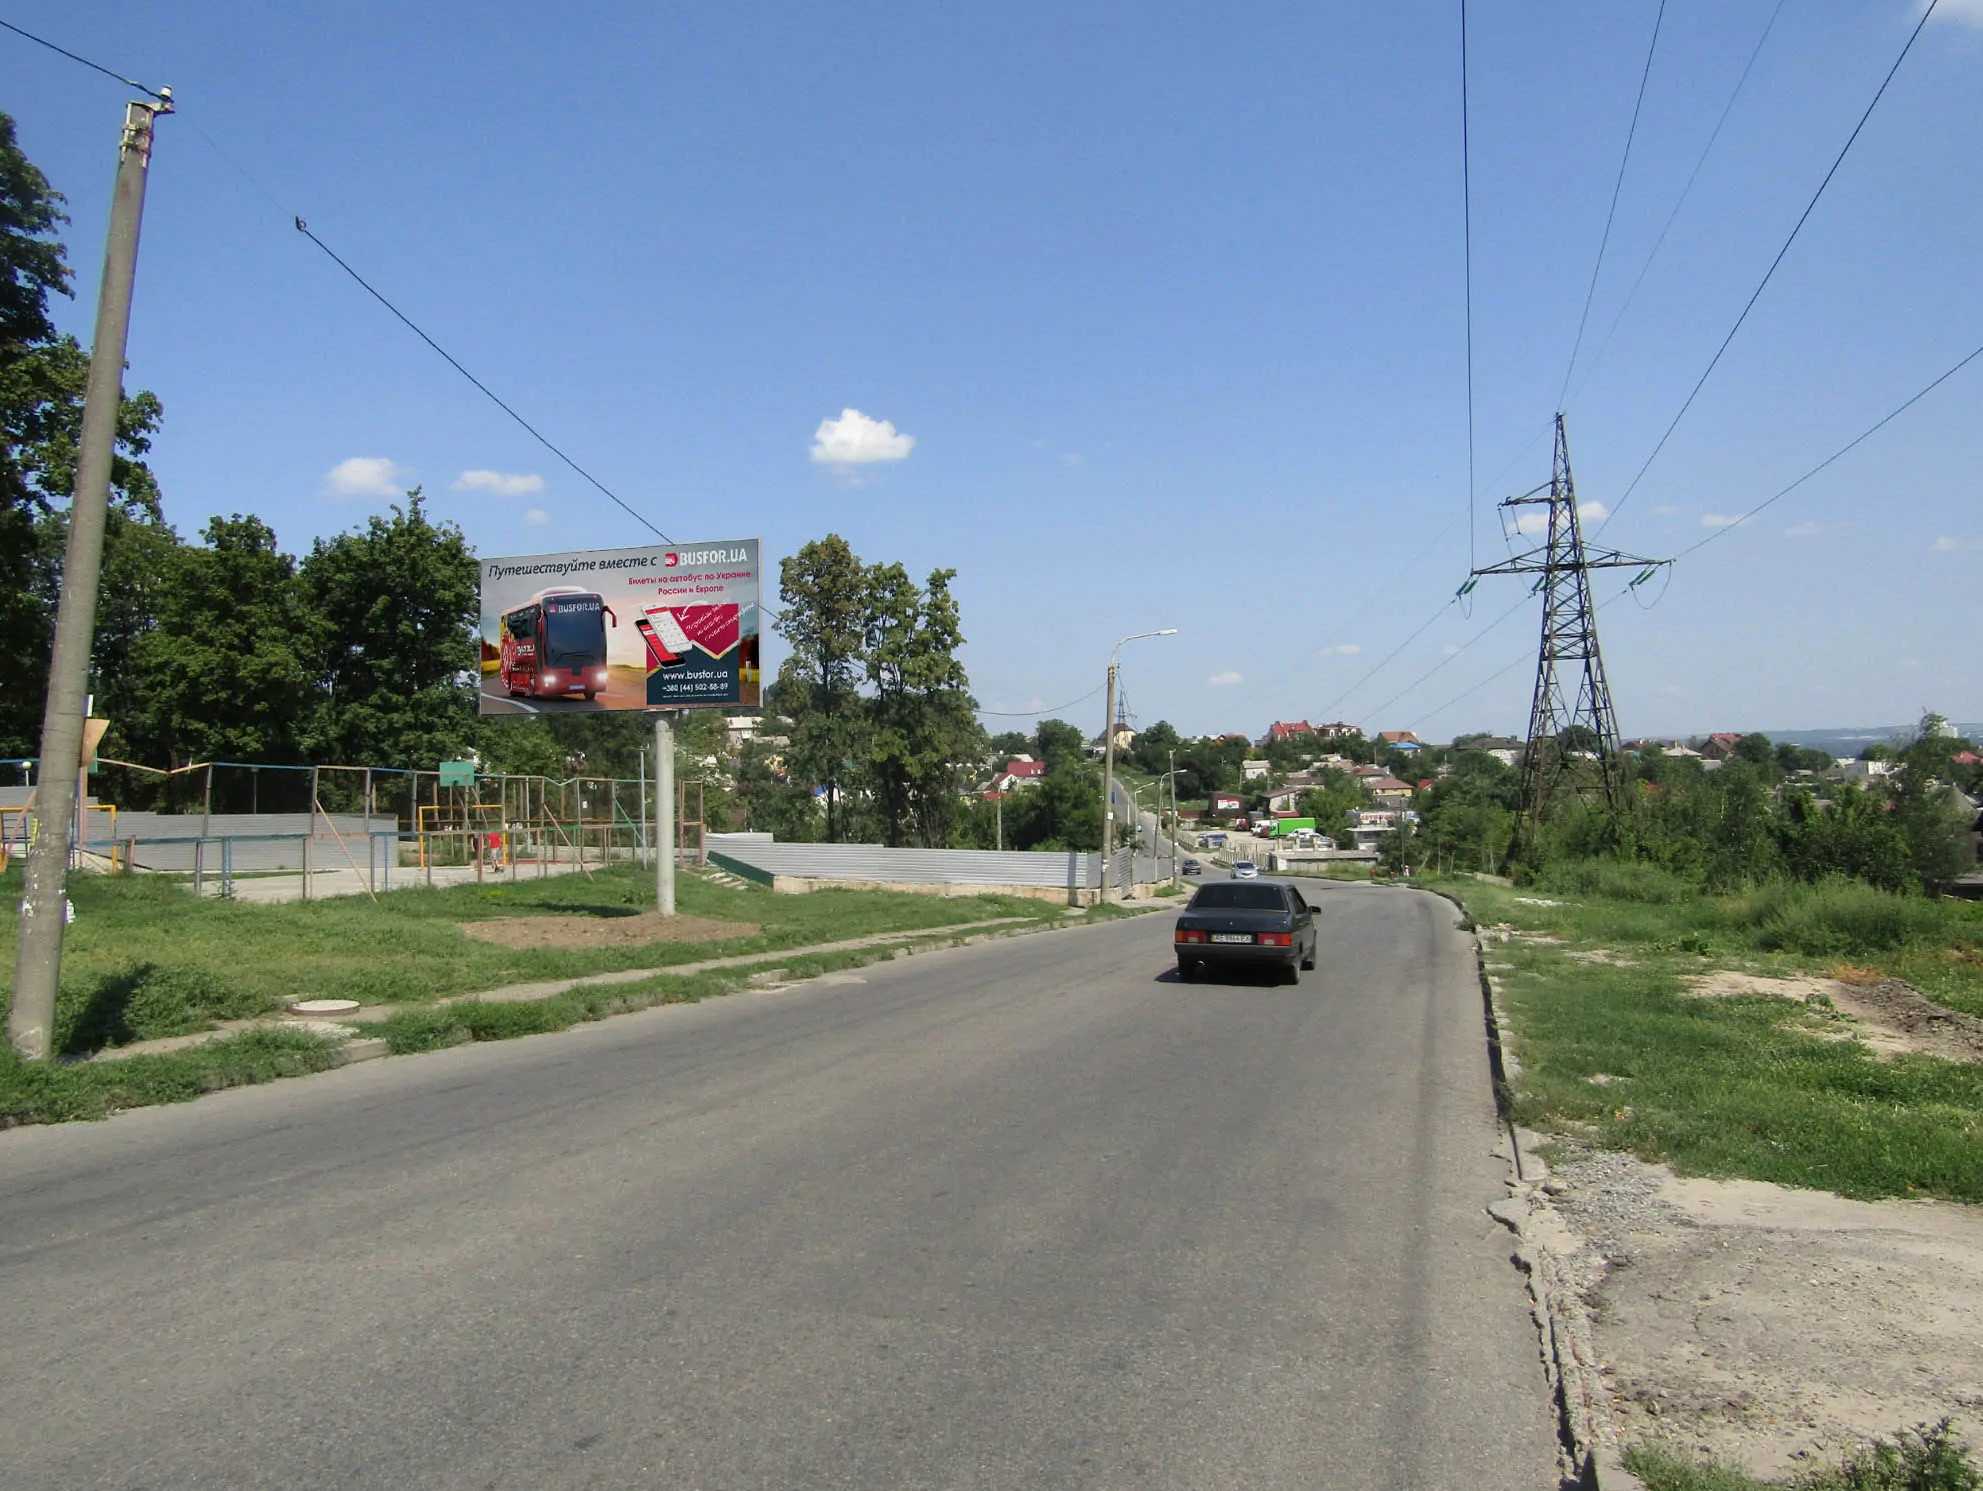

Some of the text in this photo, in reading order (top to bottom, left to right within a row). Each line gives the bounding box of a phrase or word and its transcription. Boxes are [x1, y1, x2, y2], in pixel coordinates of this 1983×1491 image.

[488, 548, 747, 580] Путешествуйте вместе с BUSFOR.UA
[628, 577, 657, 585] Билеты
[669, 573, 702, 583] автобус
[716, 571, 751, 581] Украине
[658, 587, 687, 595] России
[695, 585, 724, 594] Европе
[558, 602, 600, 613] BUSFOR.UA
[662, 669, 728, 680] www.busfor.ua
